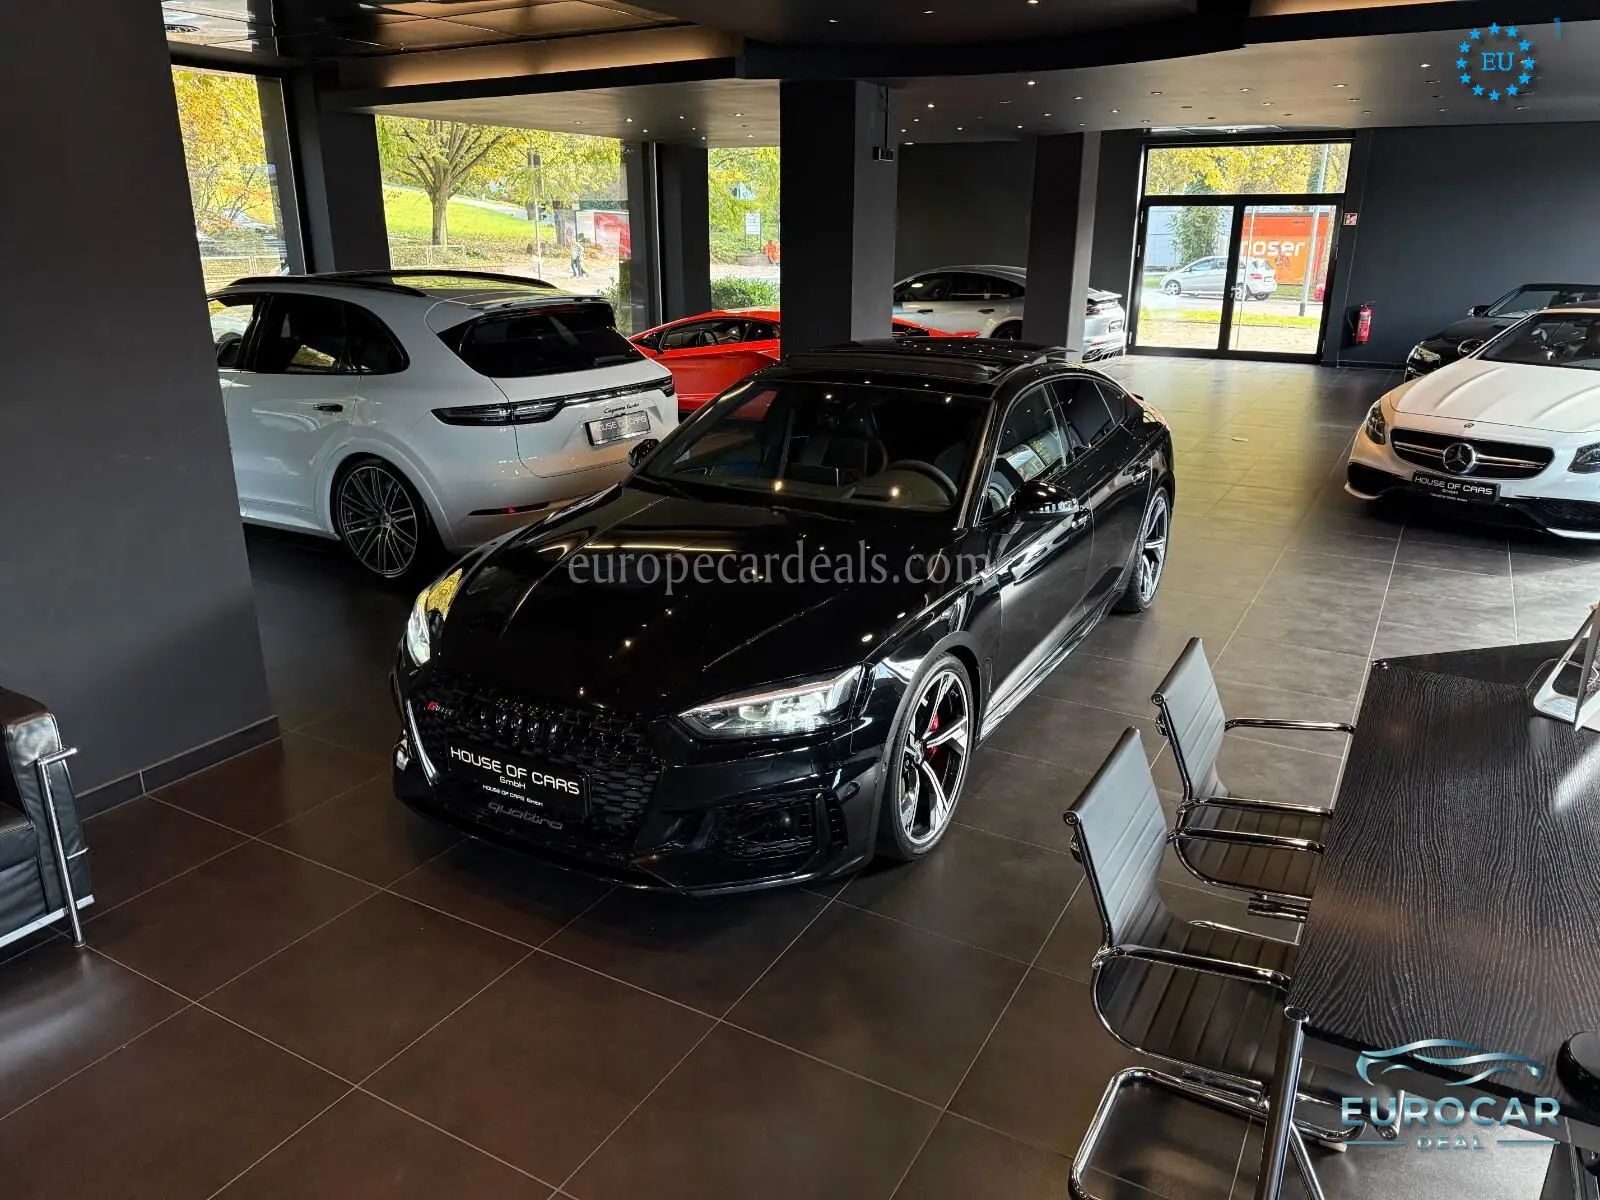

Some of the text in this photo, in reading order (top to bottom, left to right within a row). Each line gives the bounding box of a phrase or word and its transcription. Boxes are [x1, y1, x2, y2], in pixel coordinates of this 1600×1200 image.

[1414, 476, 1493, 495] HOUSE OF CARS
[450, 746, 580, 795] HOUSE OF CARS
[482, 784, 501, 794] HOUSE
[499, 776, 526, 790] GmbH
[487, 801, 564, 830] quattro
